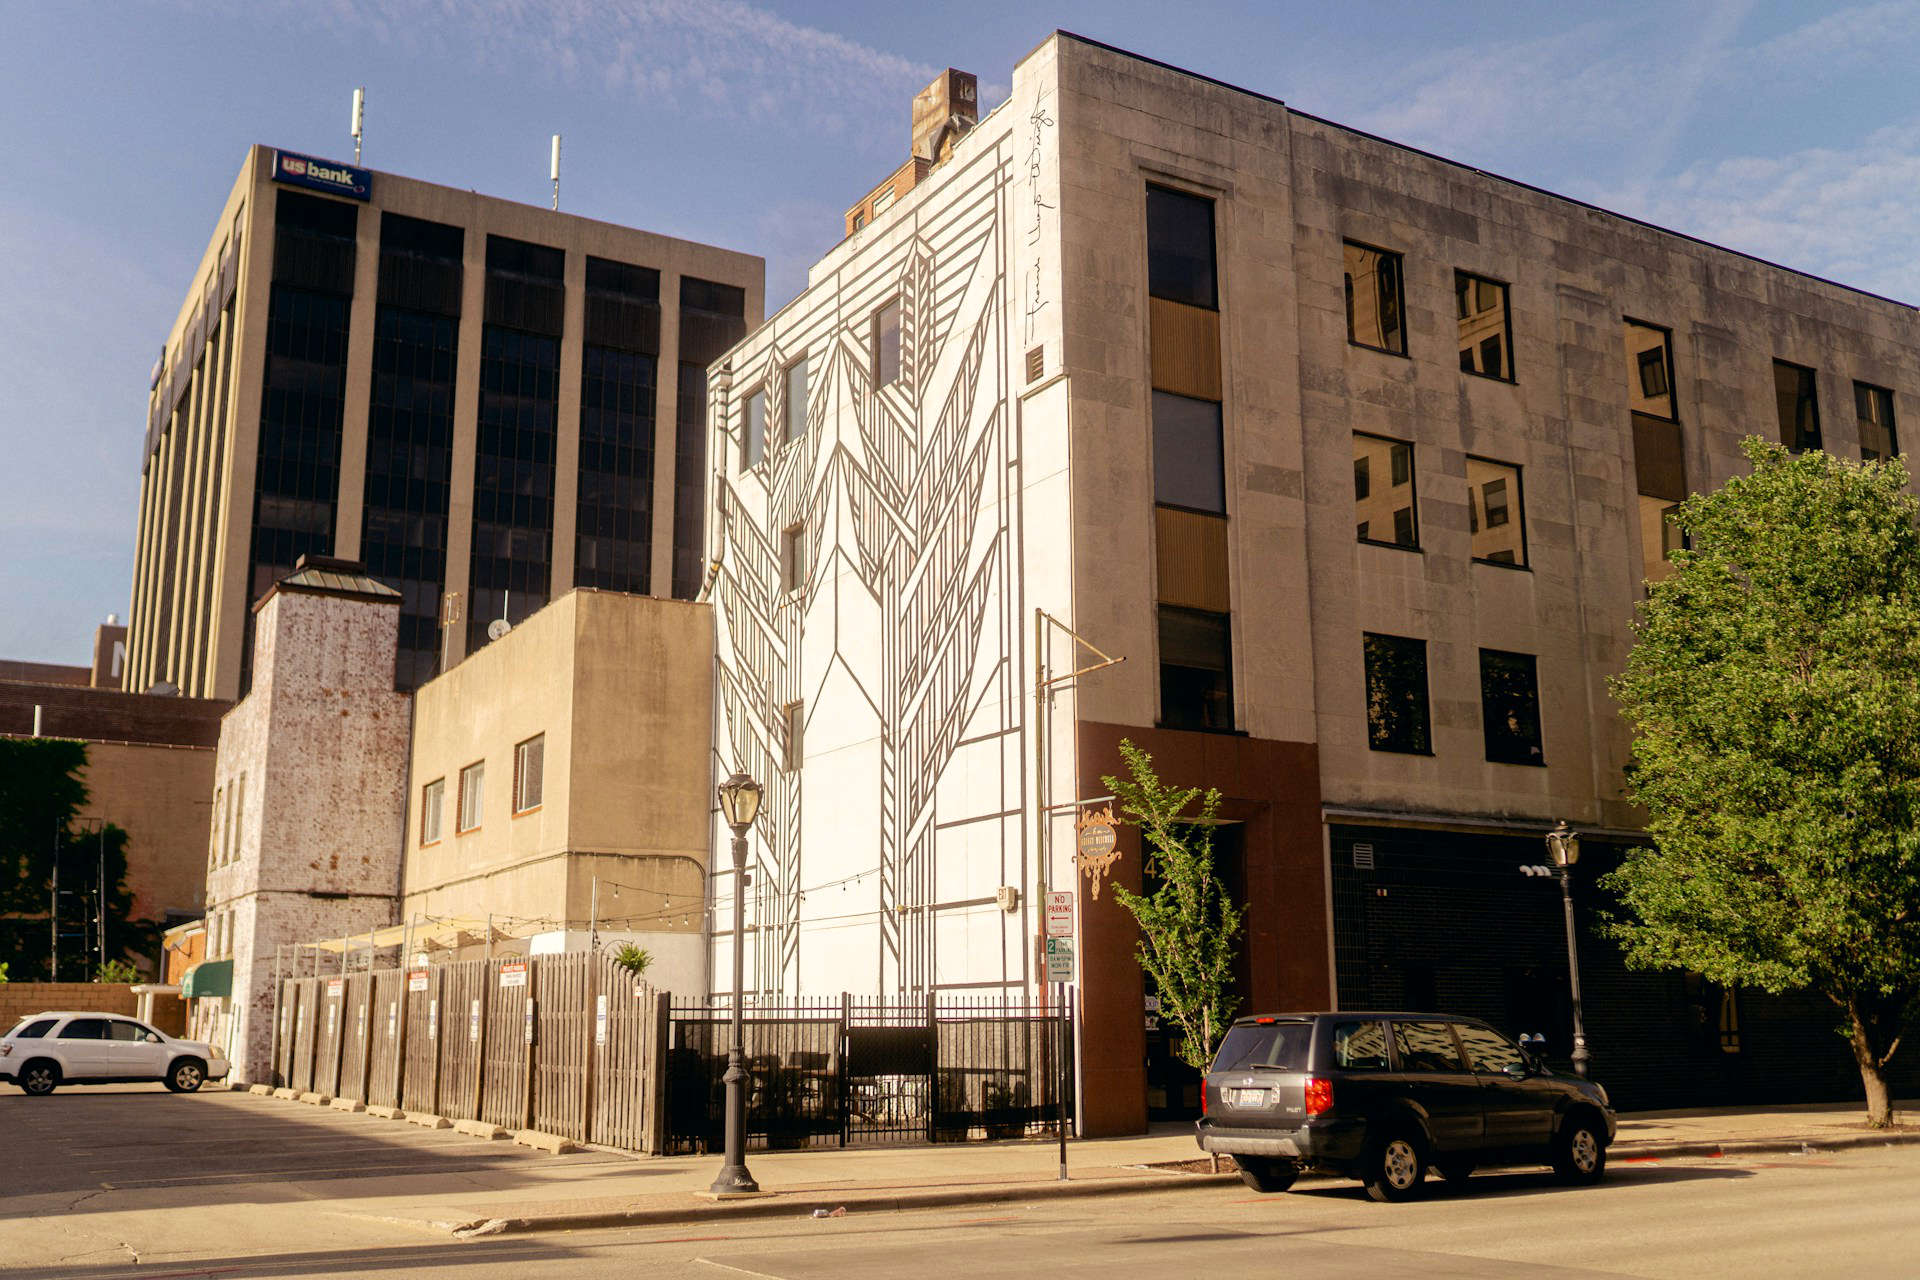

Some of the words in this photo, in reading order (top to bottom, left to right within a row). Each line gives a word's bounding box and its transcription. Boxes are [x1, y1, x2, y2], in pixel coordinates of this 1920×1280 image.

[283, 160, 305, 173] us
[307, 162, 353, 184] bank
[1054, 895, 1065, 904] NO
[1048, 904, 1072, 913] PARKING
[1048, 941, 1054, 952] 2
